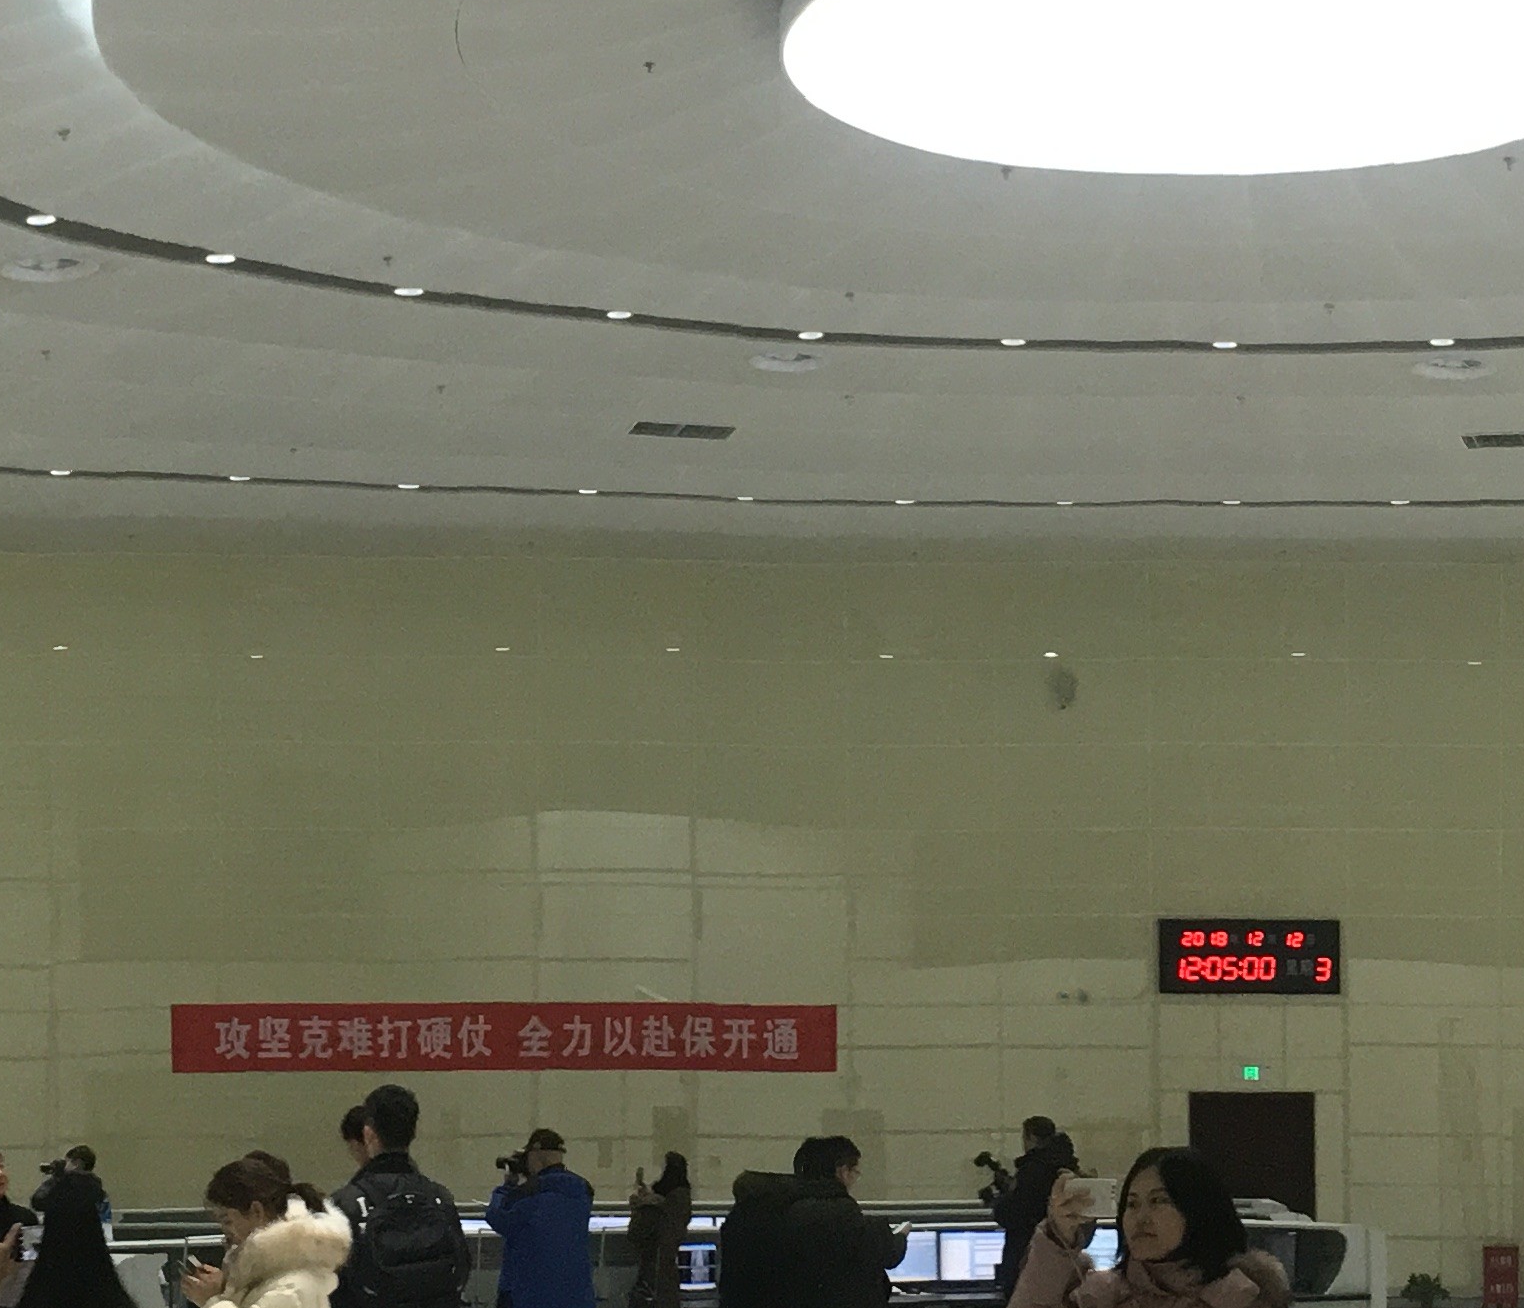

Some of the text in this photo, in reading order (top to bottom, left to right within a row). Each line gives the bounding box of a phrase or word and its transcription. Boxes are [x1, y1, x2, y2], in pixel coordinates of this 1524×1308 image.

[1177, 955, 1277, 982] 12:05:00
[214, 1014, 799, 1060] 攻坚克难打硬仗 全力以赴保开通
